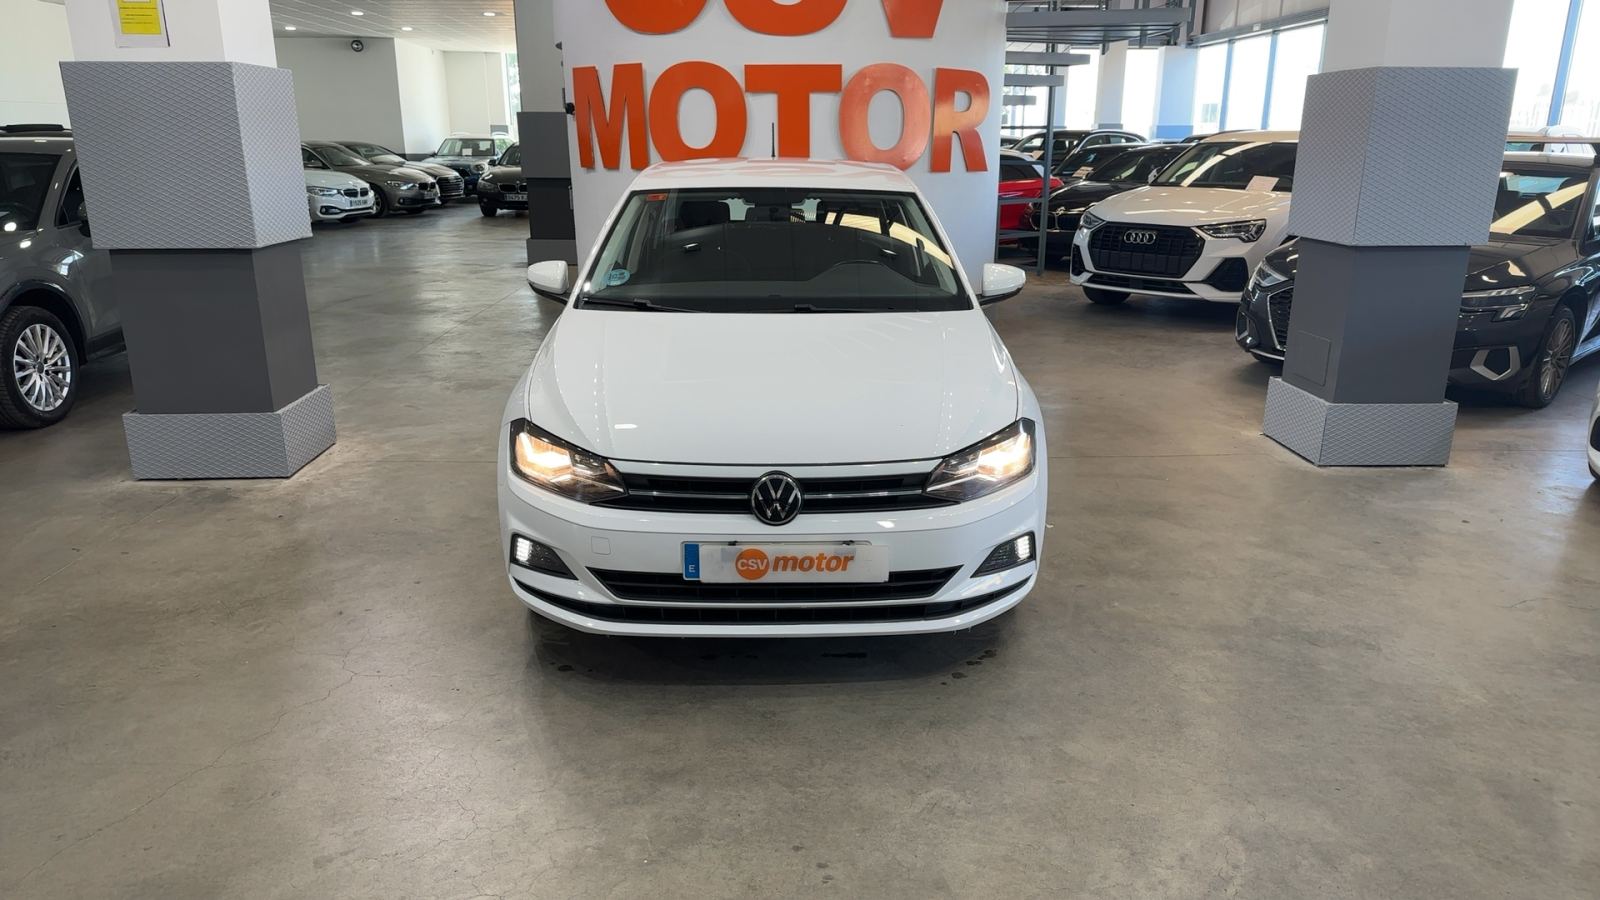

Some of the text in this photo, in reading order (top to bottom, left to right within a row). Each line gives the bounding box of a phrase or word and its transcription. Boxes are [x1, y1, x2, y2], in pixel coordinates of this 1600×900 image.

[572, 61, 988, 172] MOTOR
[688, 564, 696, 573] E
[737, 552, 855, 573] CSV motor
